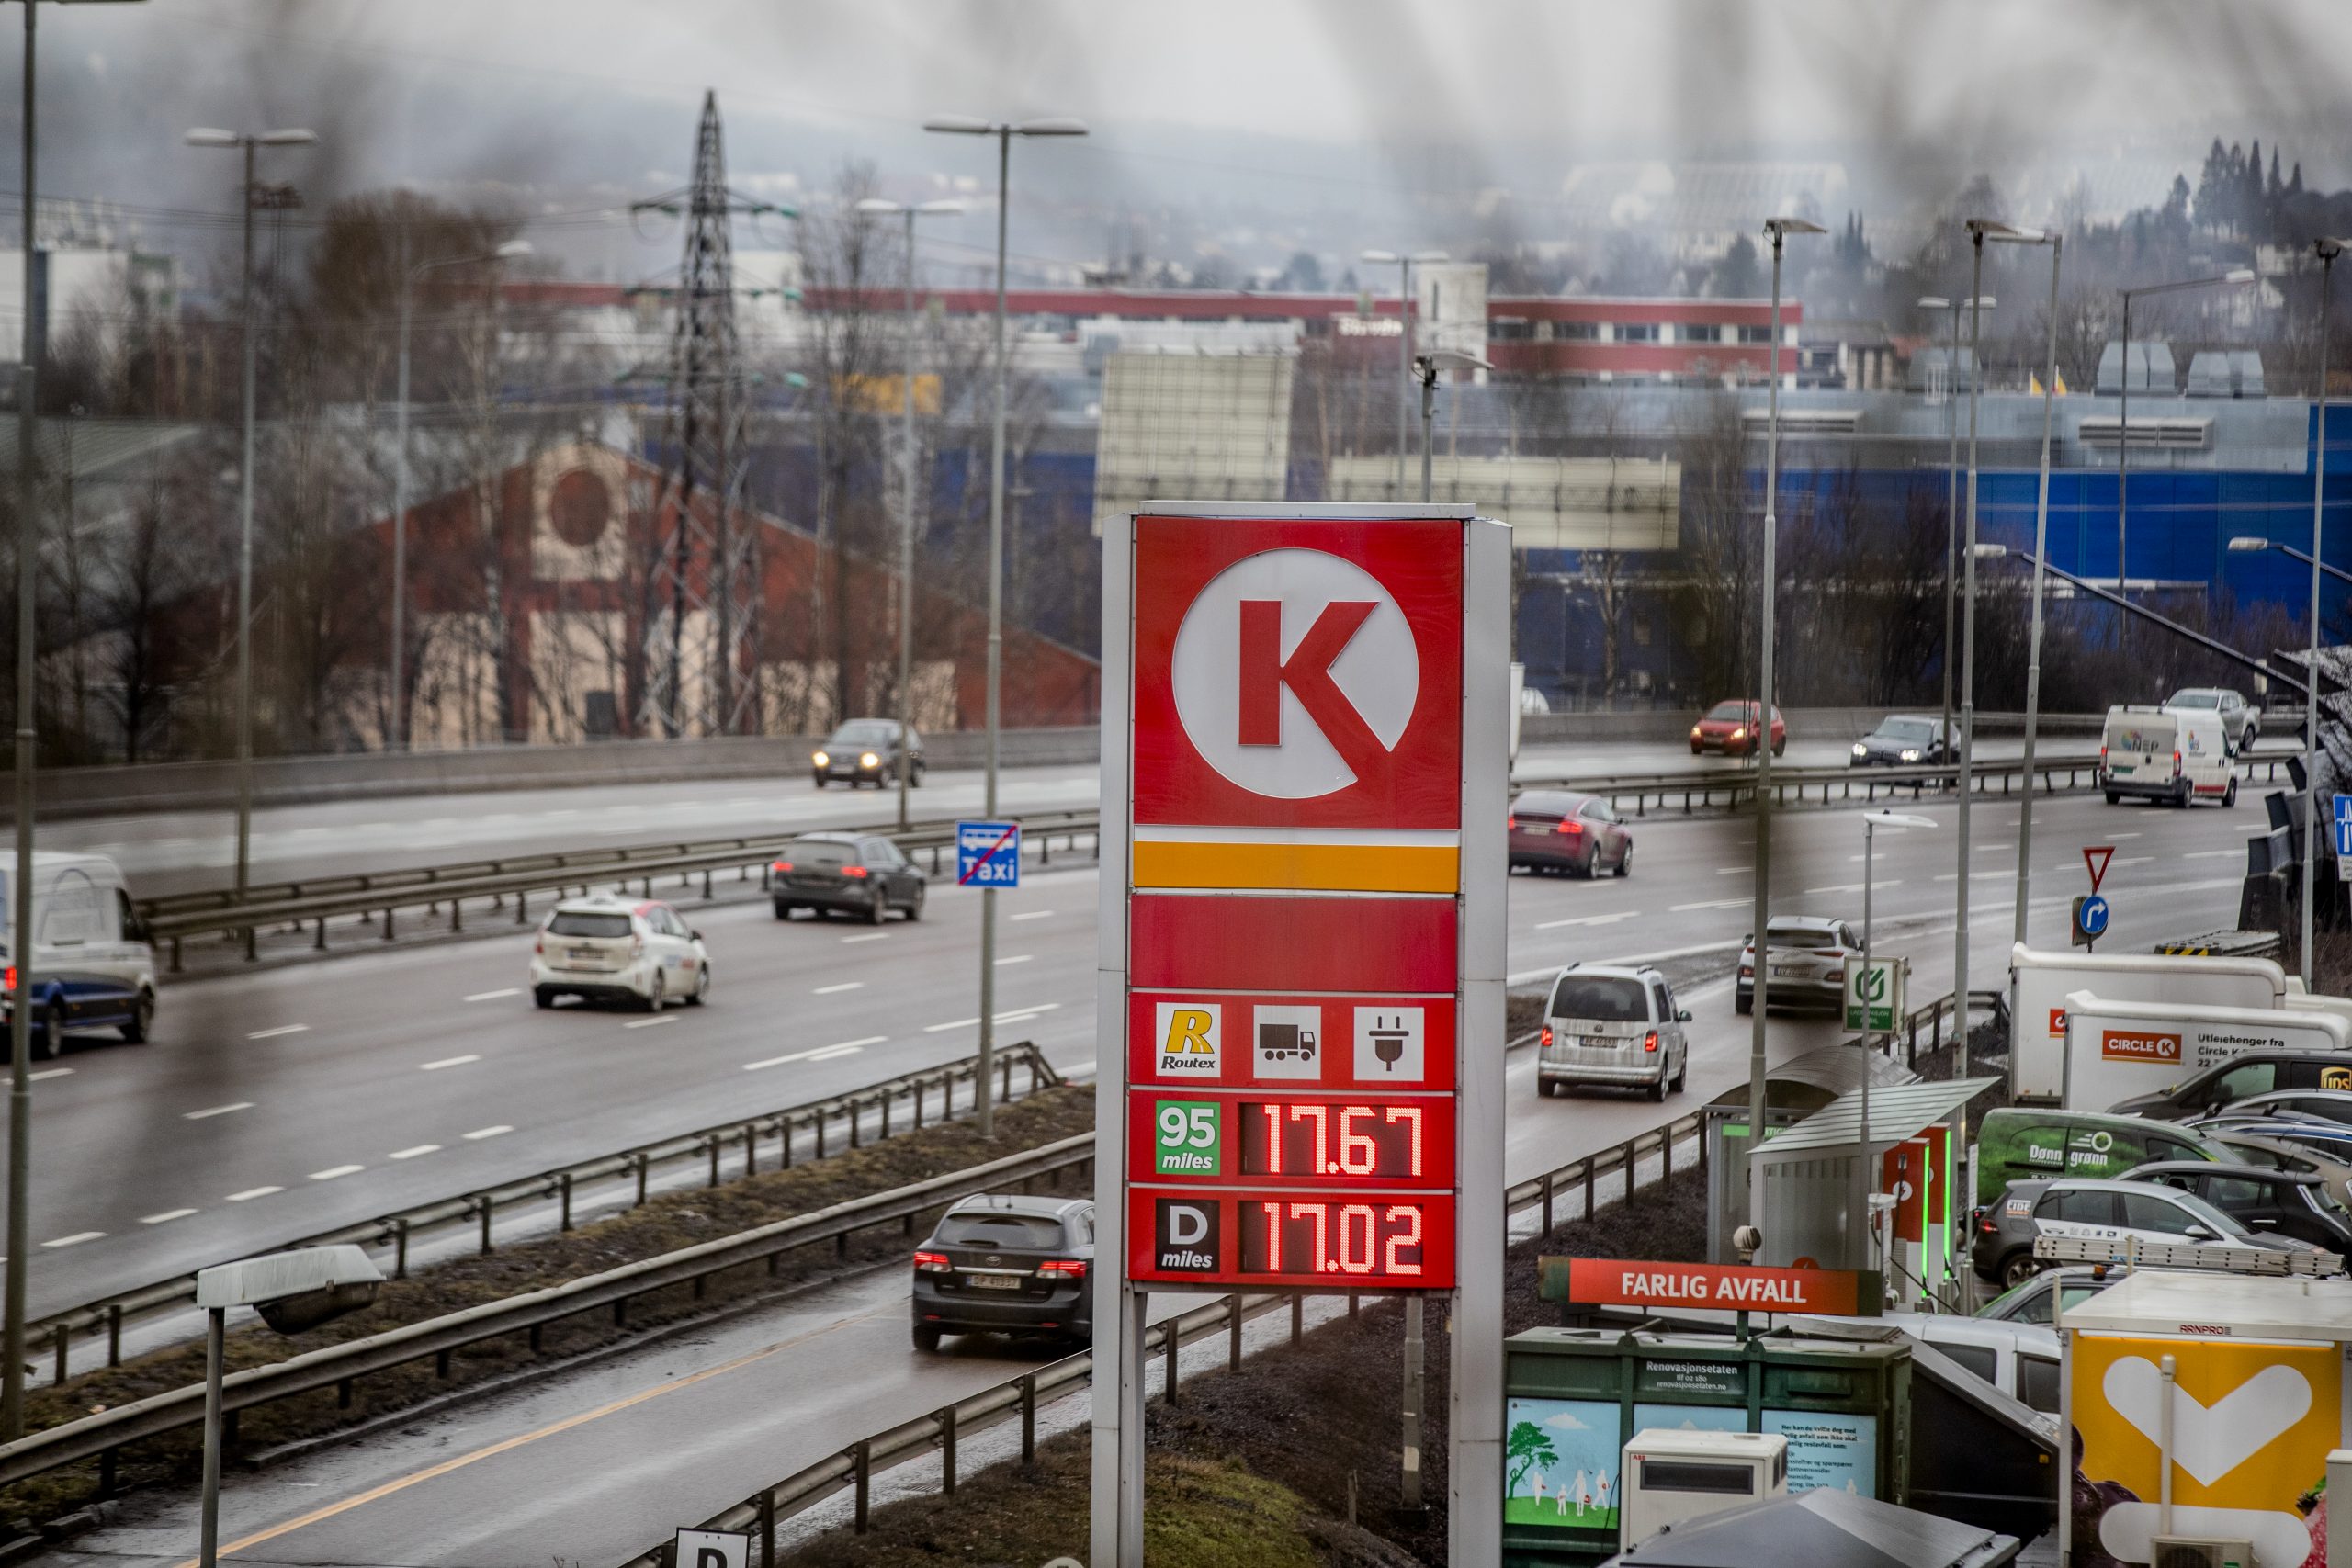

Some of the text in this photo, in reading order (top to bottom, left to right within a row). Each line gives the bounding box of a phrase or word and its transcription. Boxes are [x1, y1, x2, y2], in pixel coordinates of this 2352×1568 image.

[961, 856, 1015, 881] Taxi
[2109, 1038, 2154, 1052] CIRCLE
[2198, 1046, 2228, 1055] Circle
[2269, 1038, 2285, 1047] fra
[1161, 1055, 1216, 1069] Routex
[1159, 1106, 1216, 1148] 95
[1264, 1104, 1422, 1177] 17.67
[1162, 1152, 1213, 1170] miles
[2029, 1145, 2063, 1161] Dønn
[2070, 1150, 2109, 1168] grønn
[1169, 1205, 1208, 1245] D
[1264, 1202, 1422, 1275] 17.02
[1161, 1250, 1213, 1268] miles
[1622, 1272, 1807, 1303] FARLIG AVFALL
[1646, 1361, 1738, 1374] Renovasjonsetaten
[1657, 1382, 1727, 1391] renovasjonsetaten.no
